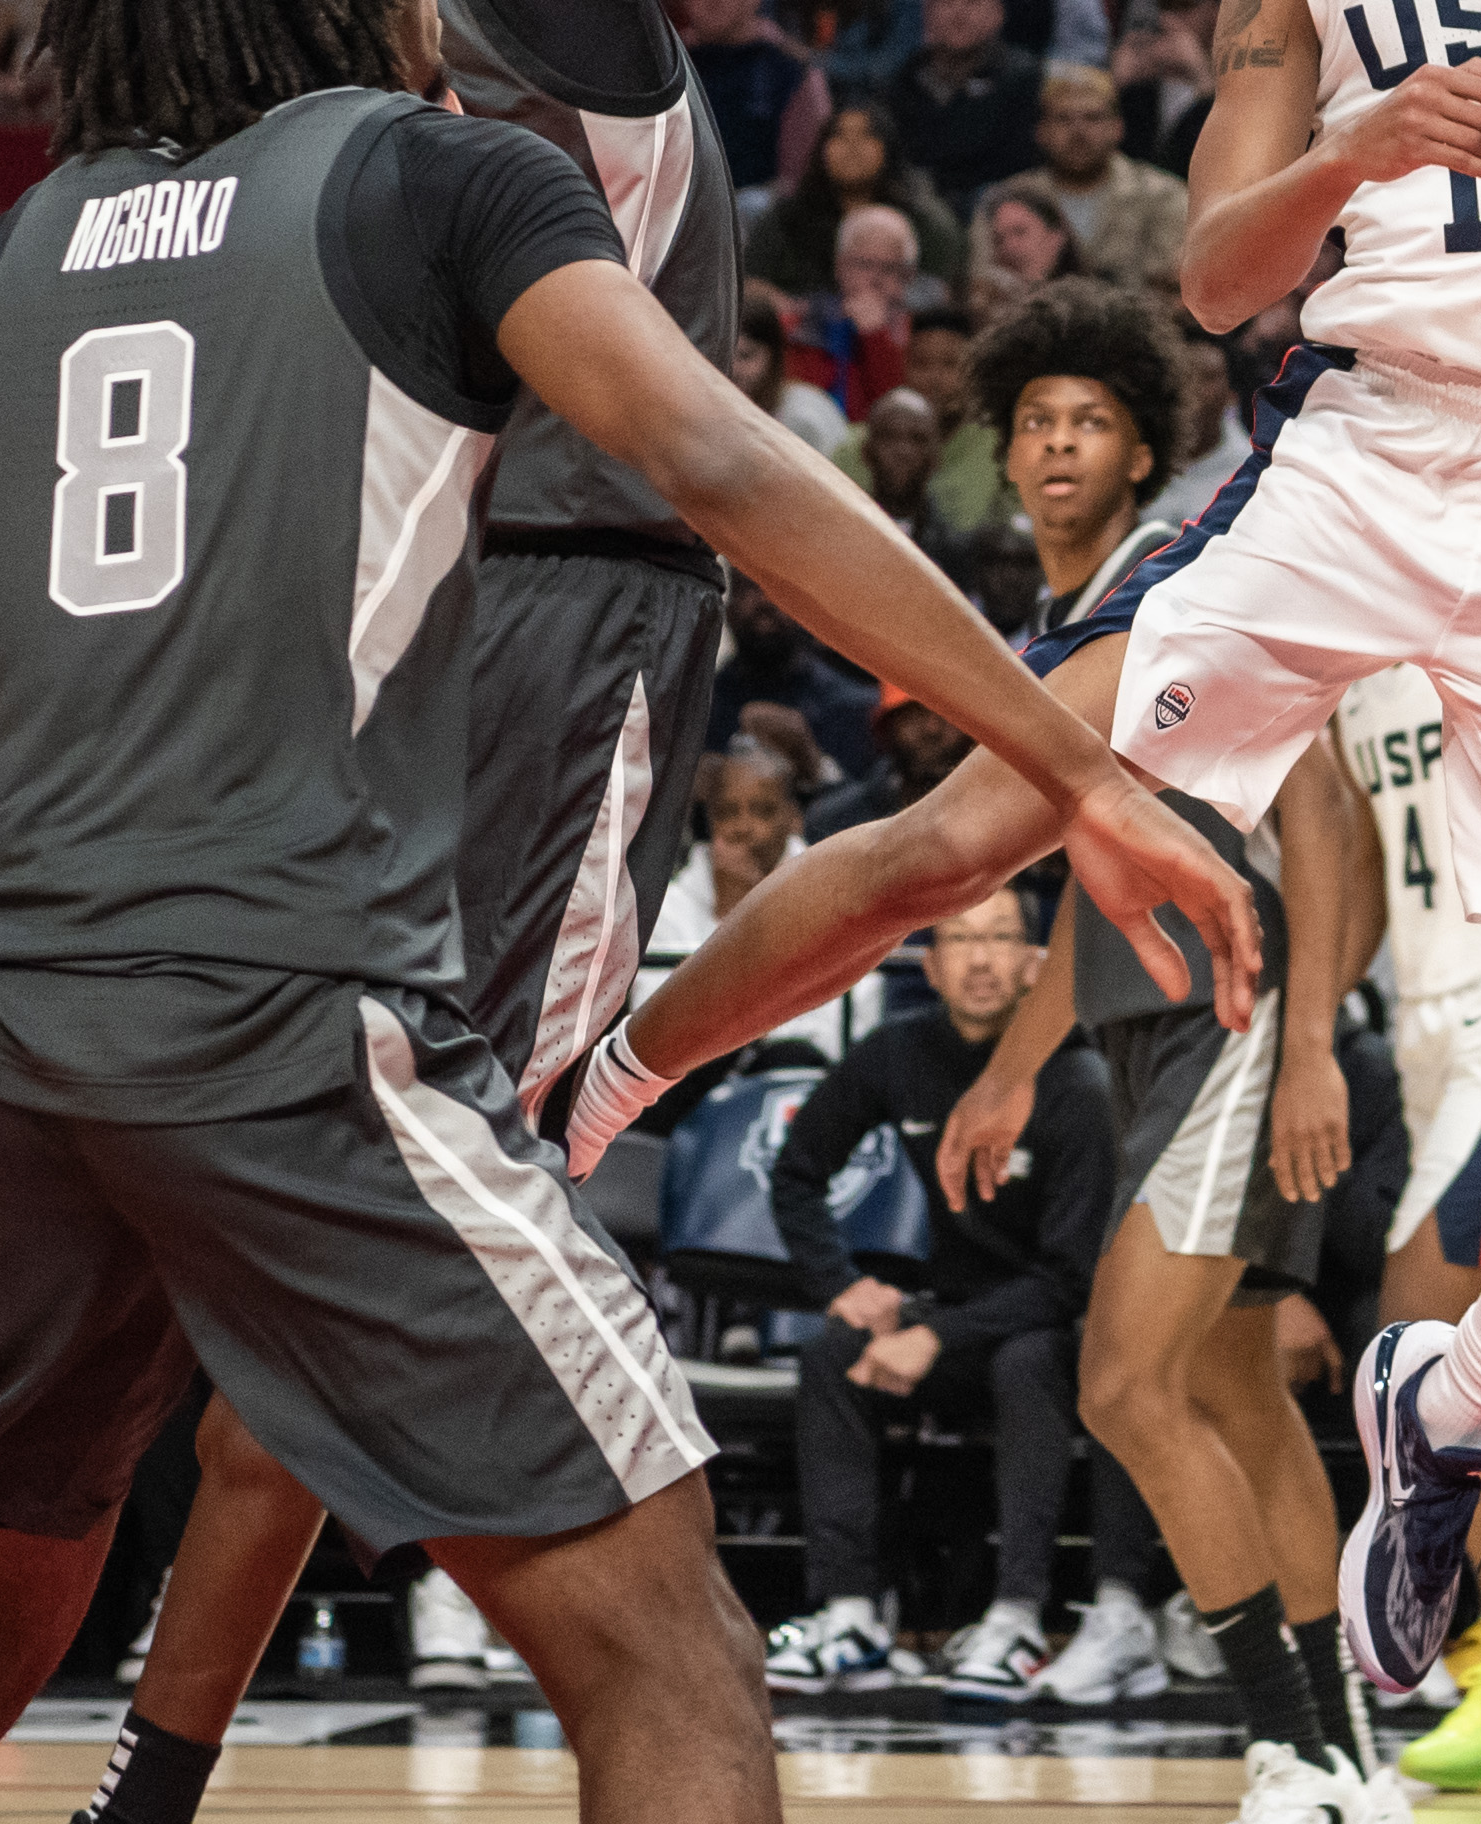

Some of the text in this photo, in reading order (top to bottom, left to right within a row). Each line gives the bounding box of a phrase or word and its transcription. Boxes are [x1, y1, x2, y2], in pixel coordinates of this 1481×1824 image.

[60, 175, 240, 273] MGBAKO
[48, 319, 195, 617] 8
[1168, 687, 1190, 709] USA
[1404, 802, 1435, 909] 4
